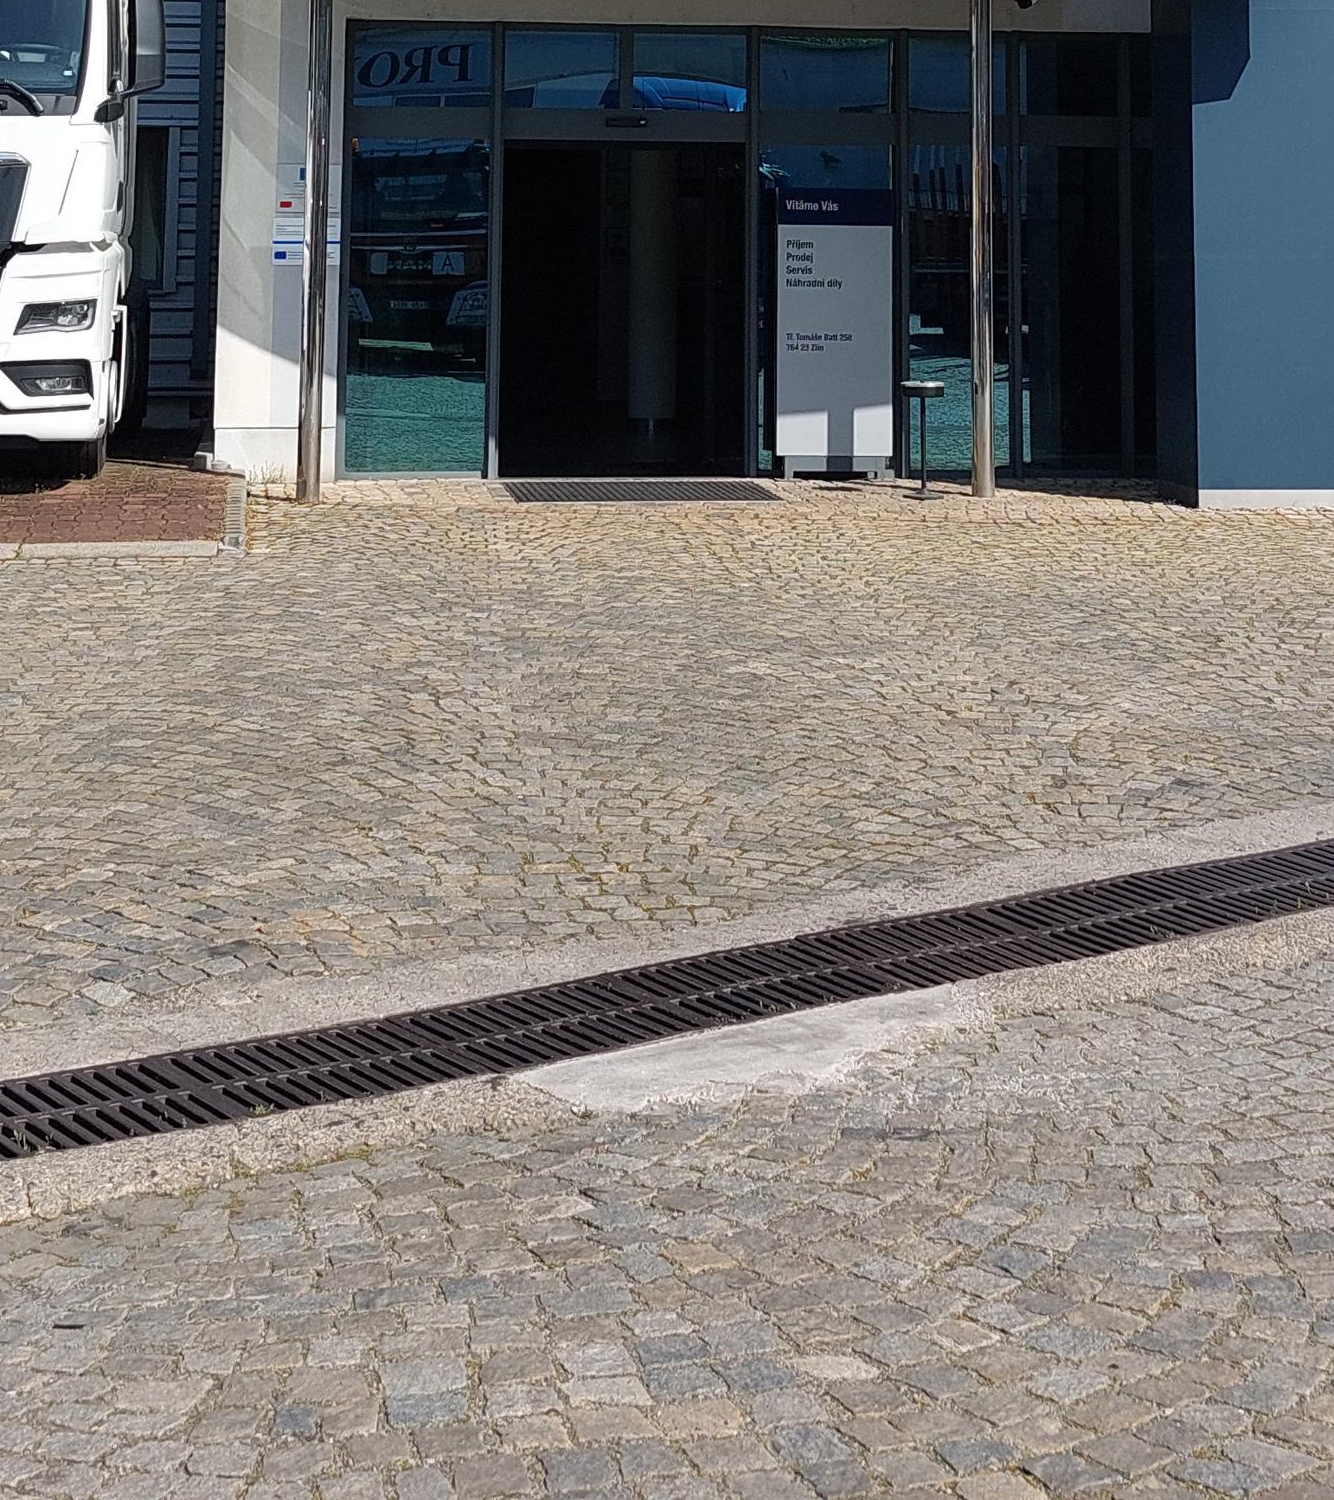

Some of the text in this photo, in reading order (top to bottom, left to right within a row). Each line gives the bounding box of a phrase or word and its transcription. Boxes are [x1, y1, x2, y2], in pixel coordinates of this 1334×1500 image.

[786, 199, 839, 211] Vítáme Vás
[786, 240, 814, 250] Příjem
[786, 253, 814, 263] Prodej
[786, 265, 813, 275] Servis
[786, 278, 843, 290] Náhradní díly
